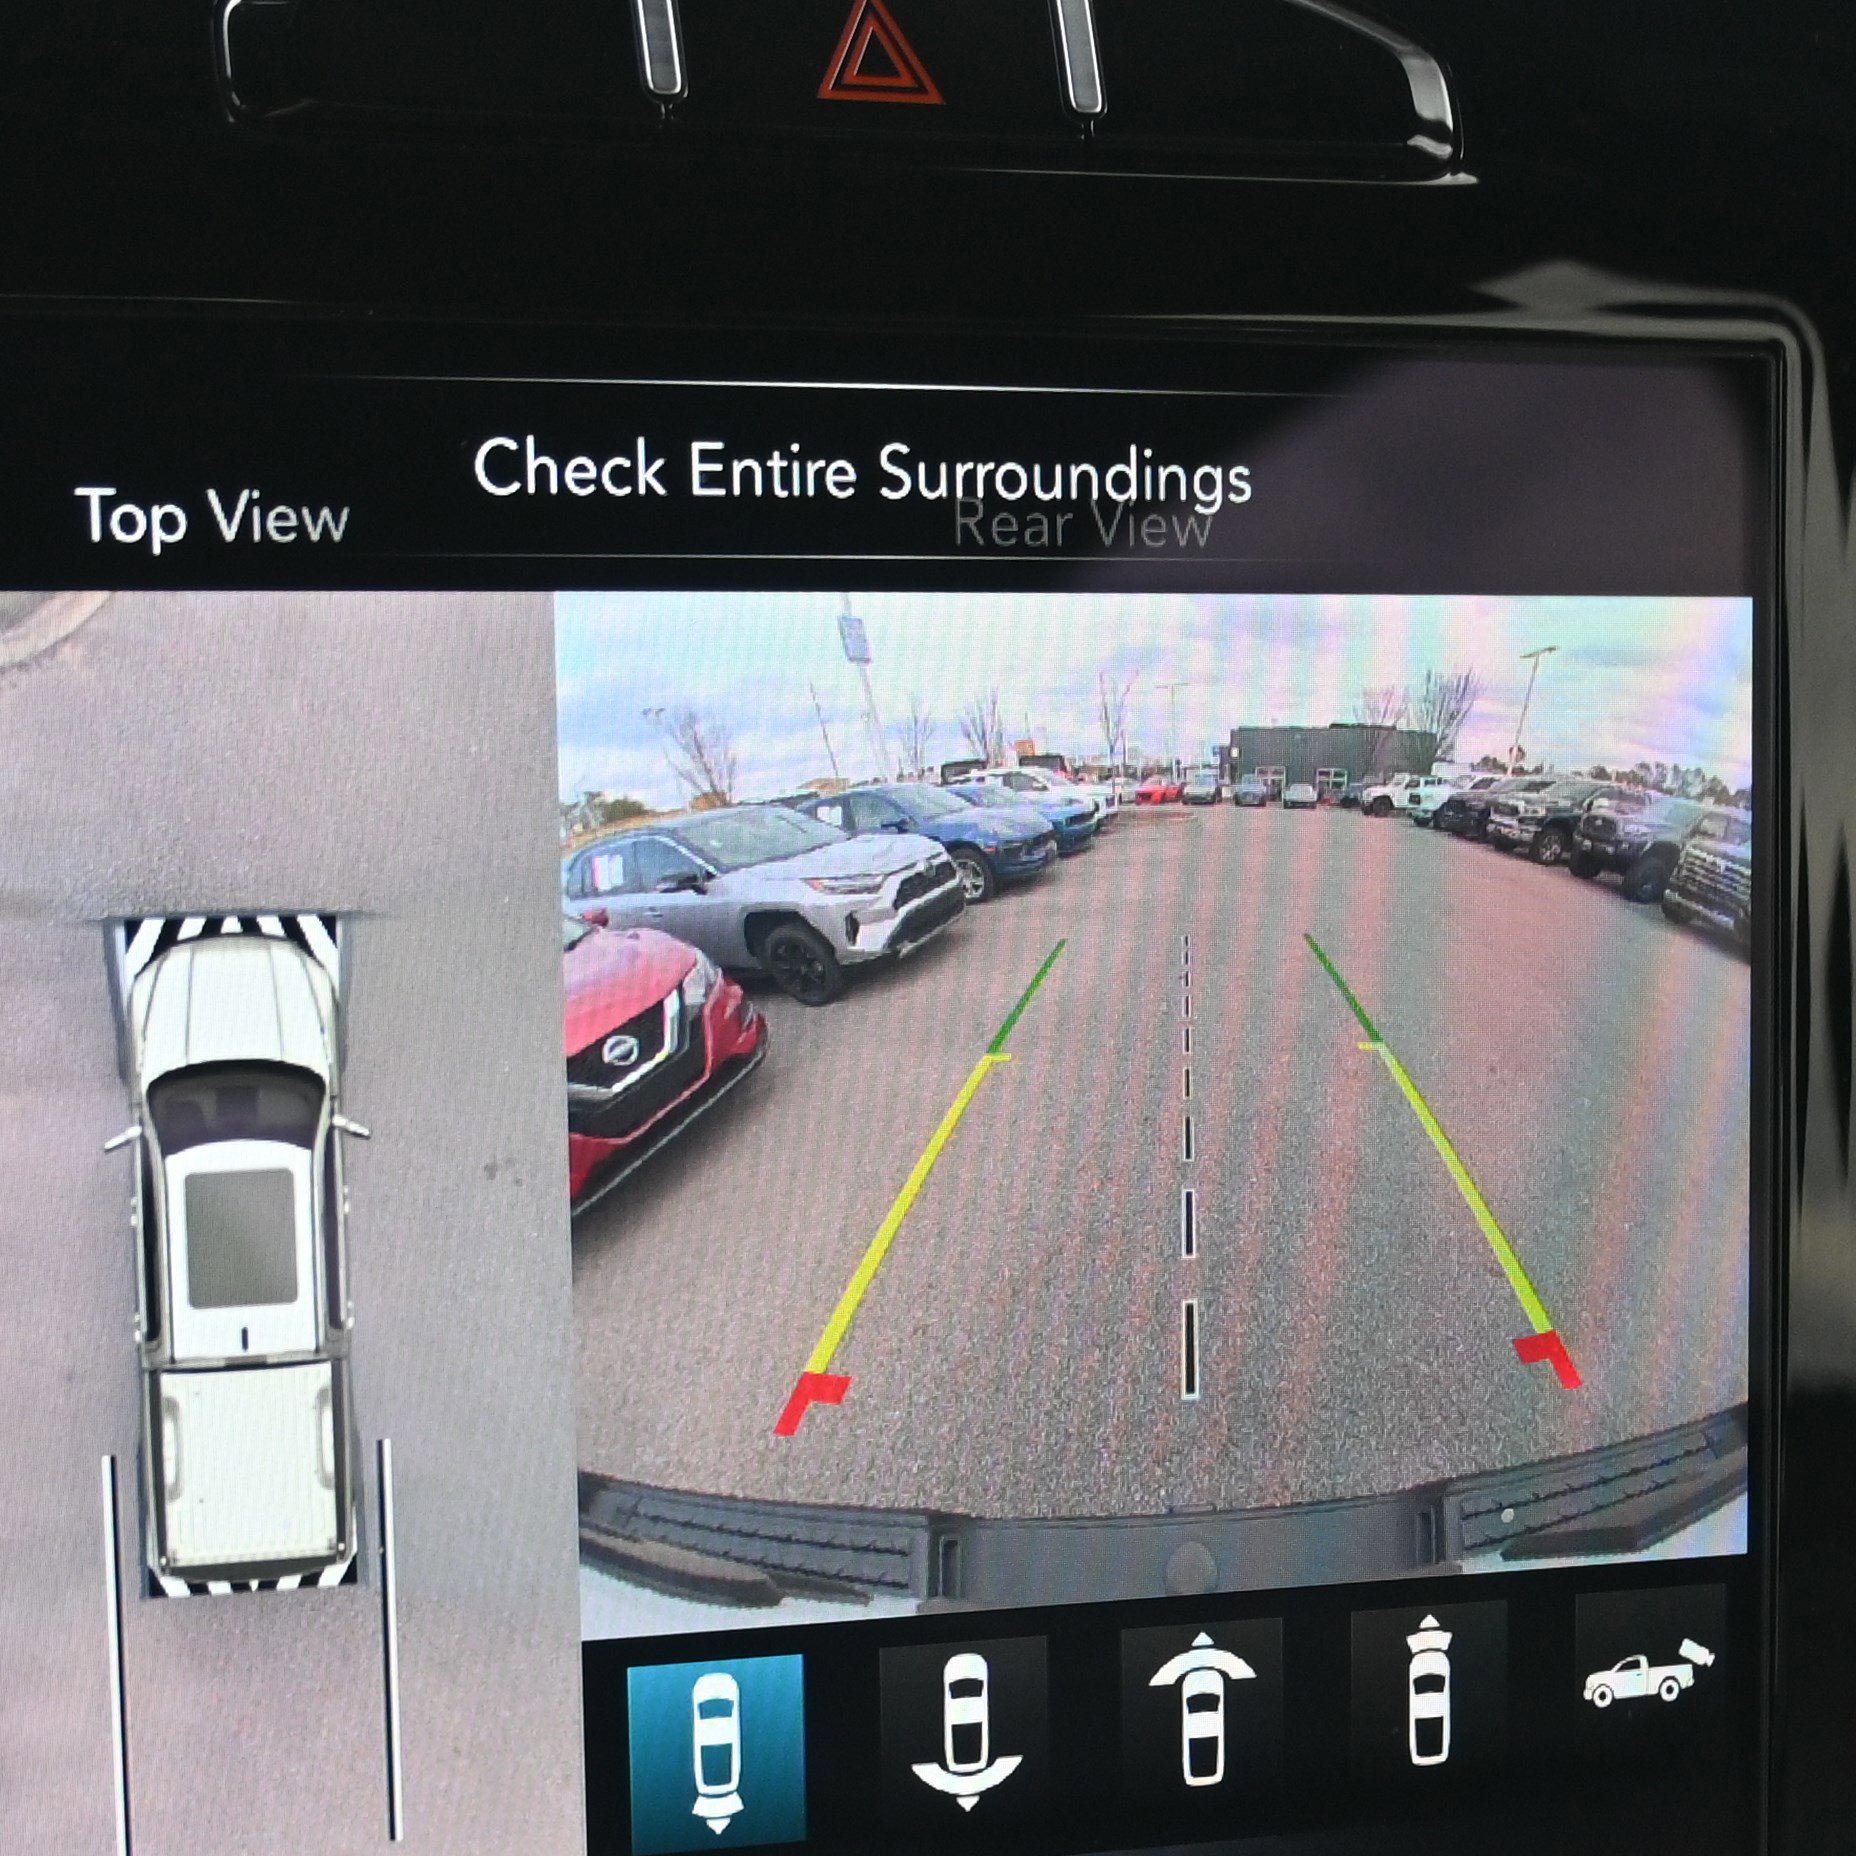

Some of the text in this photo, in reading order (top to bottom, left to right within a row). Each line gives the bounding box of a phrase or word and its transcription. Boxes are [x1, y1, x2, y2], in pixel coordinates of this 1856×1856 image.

[474, 434, 1253, 515] Check Entire Surroundings
[74, 486, 350, 555] Top View
[955, 496, 1214, 547] Rear View
